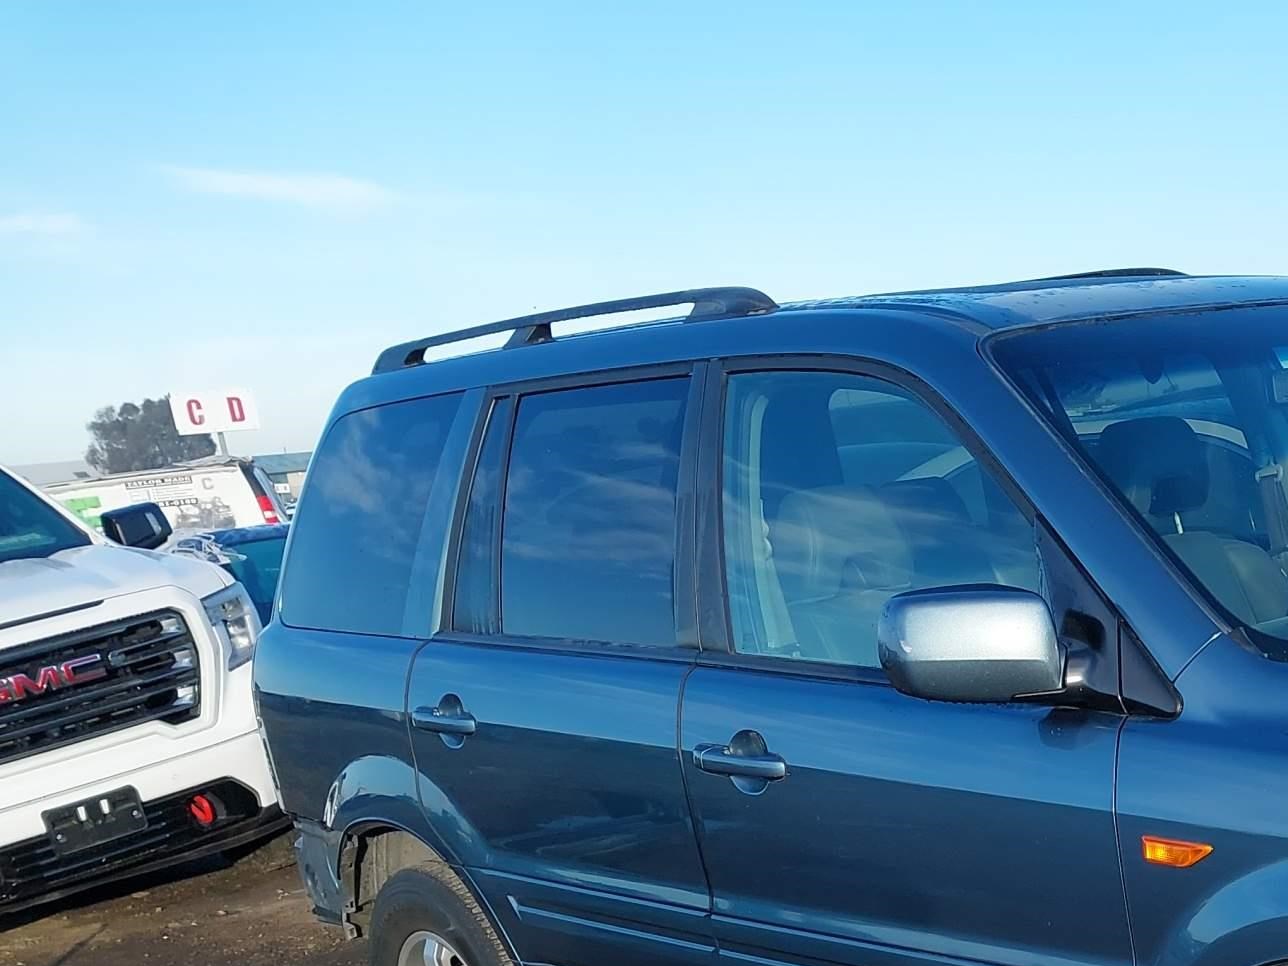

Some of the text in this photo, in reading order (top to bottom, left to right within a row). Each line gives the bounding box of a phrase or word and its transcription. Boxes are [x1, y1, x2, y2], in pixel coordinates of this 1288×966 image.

[186, 396, 246, 426] C D
[164, 475, 192, 485] MADE
[0, 653, 107, 703] MC
